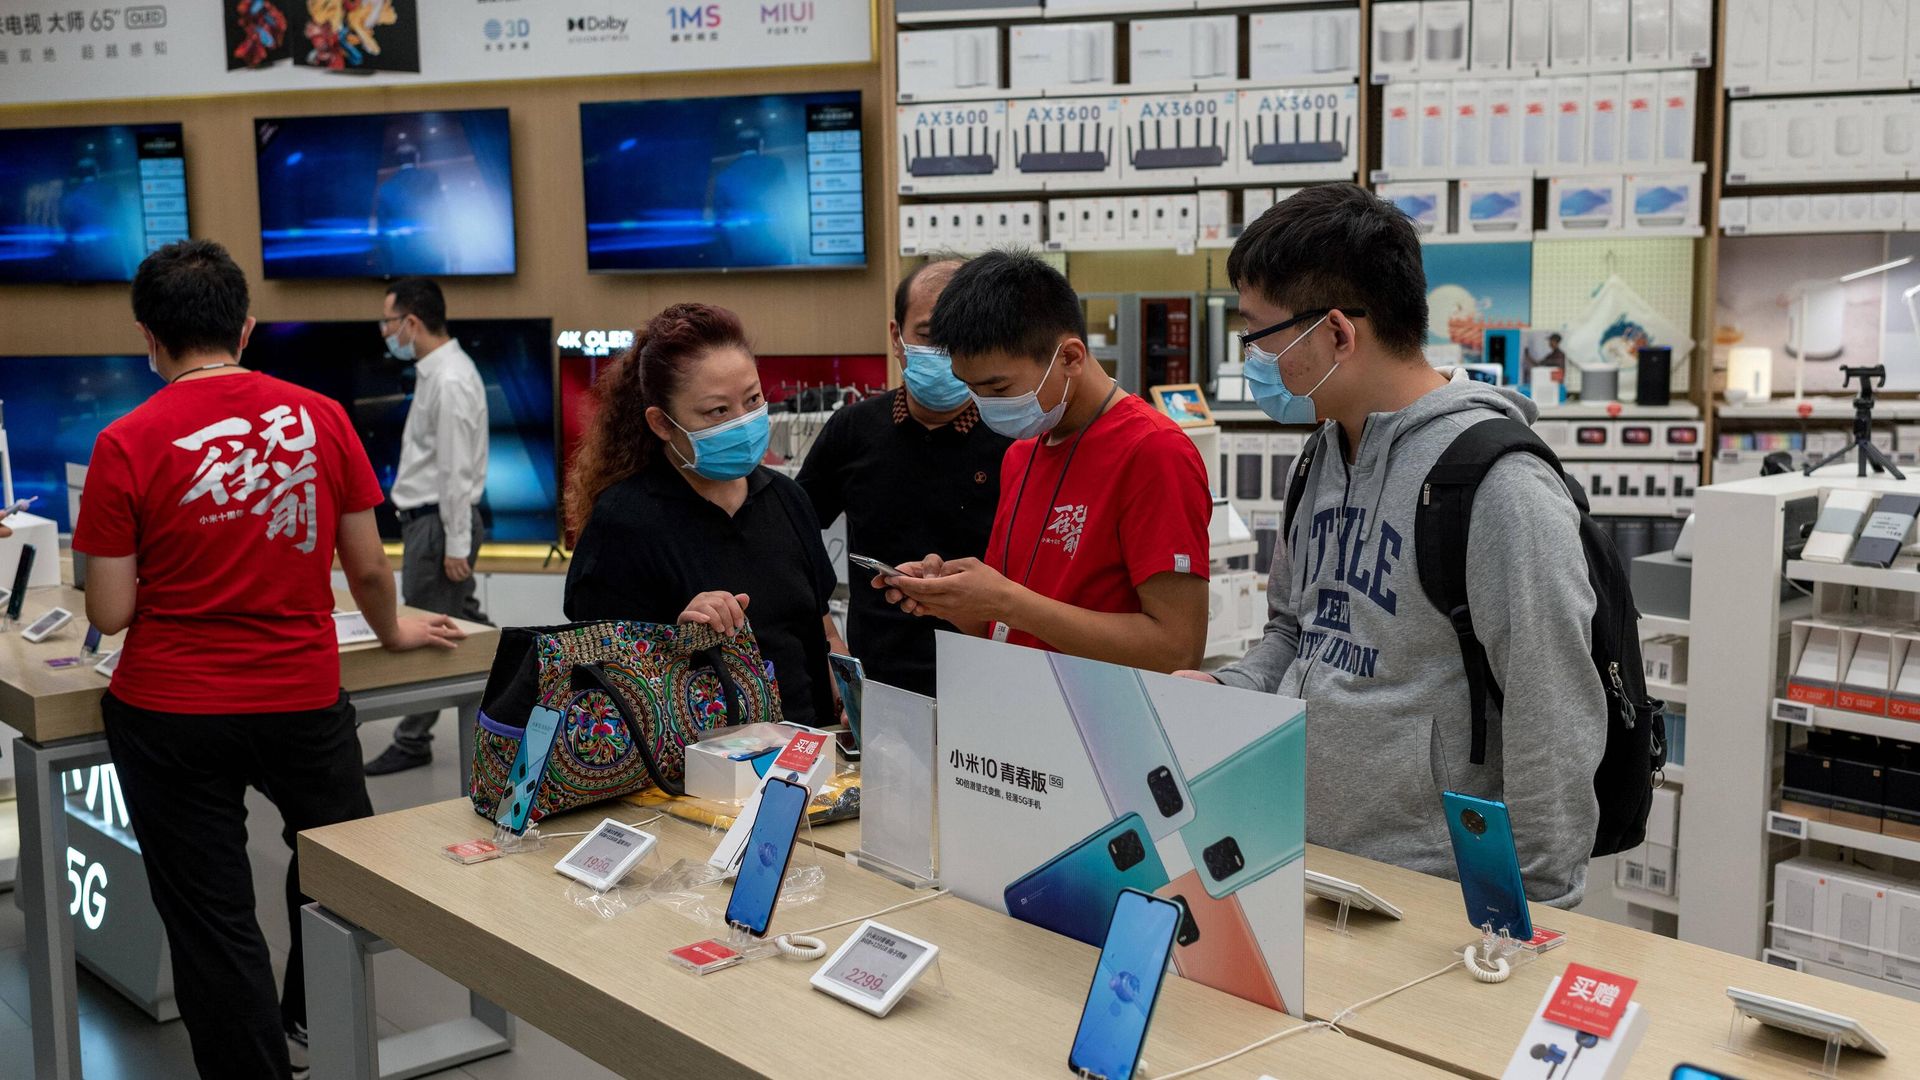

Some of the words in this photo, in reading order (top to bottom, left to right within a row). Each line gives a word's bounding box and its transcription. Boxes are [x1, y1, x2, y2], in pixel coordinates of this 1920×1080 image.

[0, 13, 42, 35] 电视
[47, 11, 84, 33] 大师
[667, 5, 721, 29] 1MS
[760, 2, 815, 24] MIUI
[505, 18, 530, 38] 3D
[588, 15, 628, 33] Dolby
[1026, 104, 1101, 122] AX3600
[1140, 99, 1218, 118] AX3600
[1258, 94, 1338, 112] AX3600
[916, 109, 989, 127] AX3600
[557, 330, 582, 349] 4K
[584, 329, 634, 349] OLED
[66, 846, 108, 931] 5G
[845, 967, 884, 991] 2299
[1567, 975, 1620, 1008] 买赠
